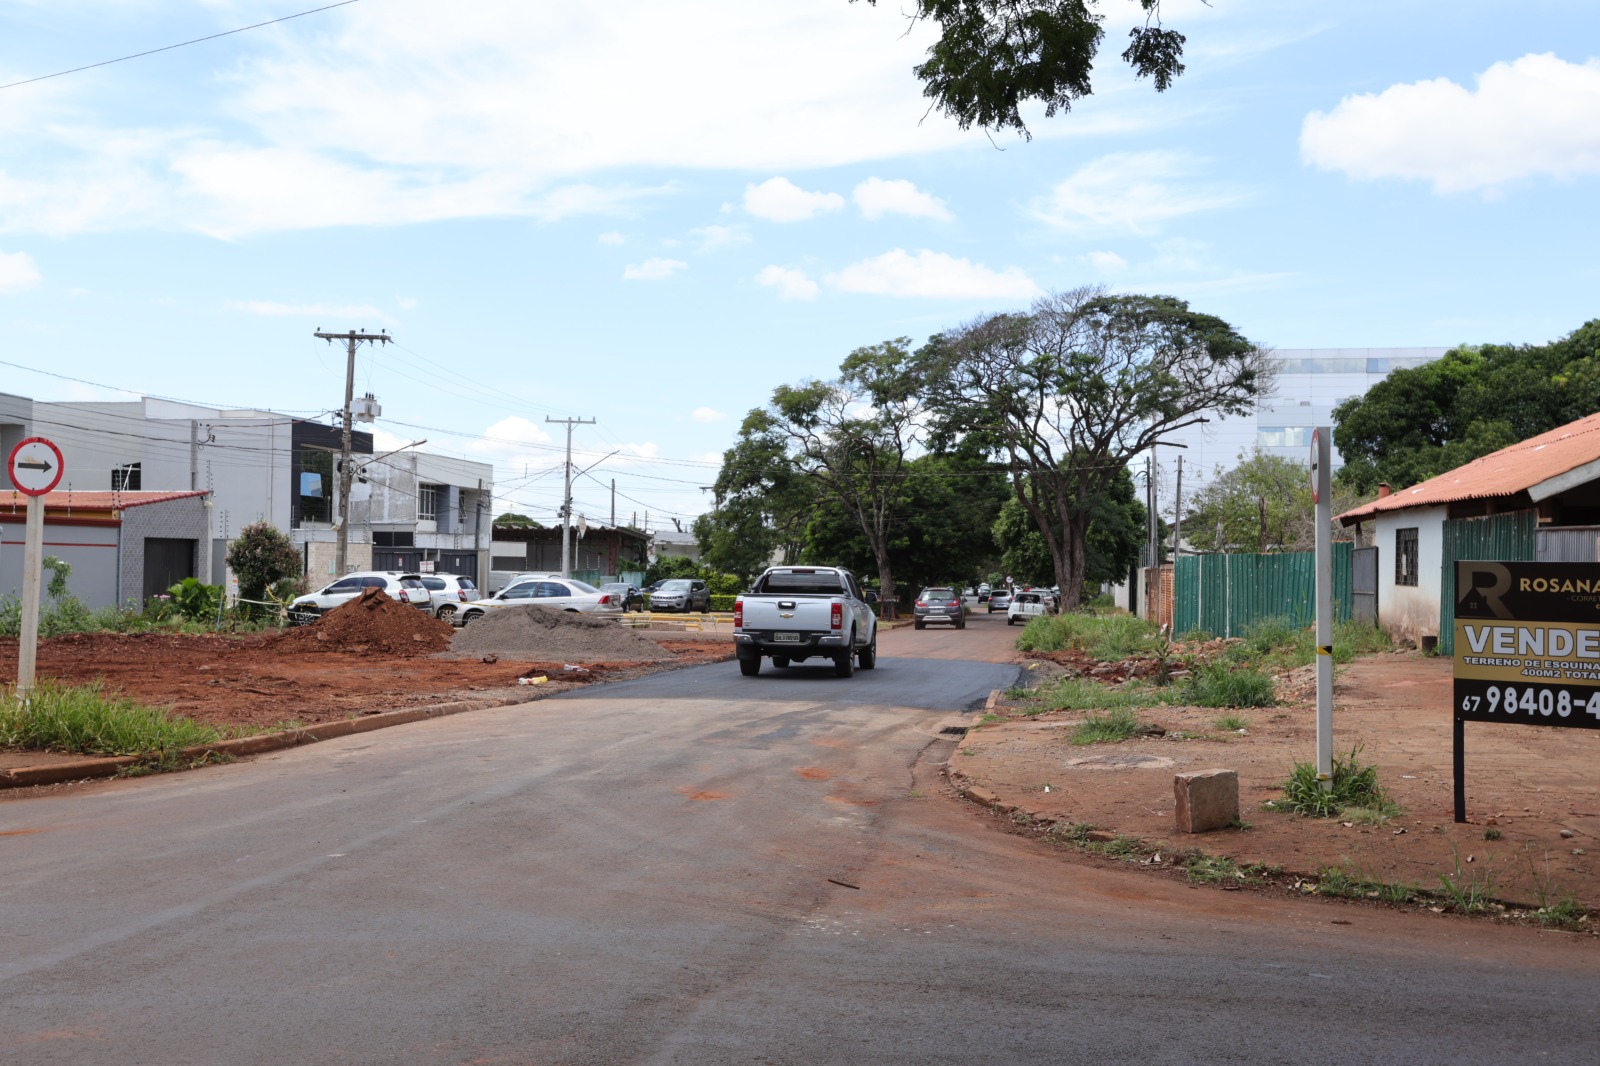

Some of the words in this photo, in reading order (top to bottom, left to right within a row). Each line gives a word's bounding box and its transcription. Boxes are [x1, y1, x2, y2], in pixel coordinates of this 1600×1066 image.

[1519, 577, 1600, 593] ROSANA
[1464, 625, 1600, 658] VENDE
[1464, 657, 1521, 666] TERRENO
[1524, 660, 1541, 668] DE
[1544, 661, 1600, 670] ESQUINA
[1521, 668, 1561, 678] 400M2
[1462, 695, 1481, 712] 67
[1486, 685, 1600, 720] 98408-4
